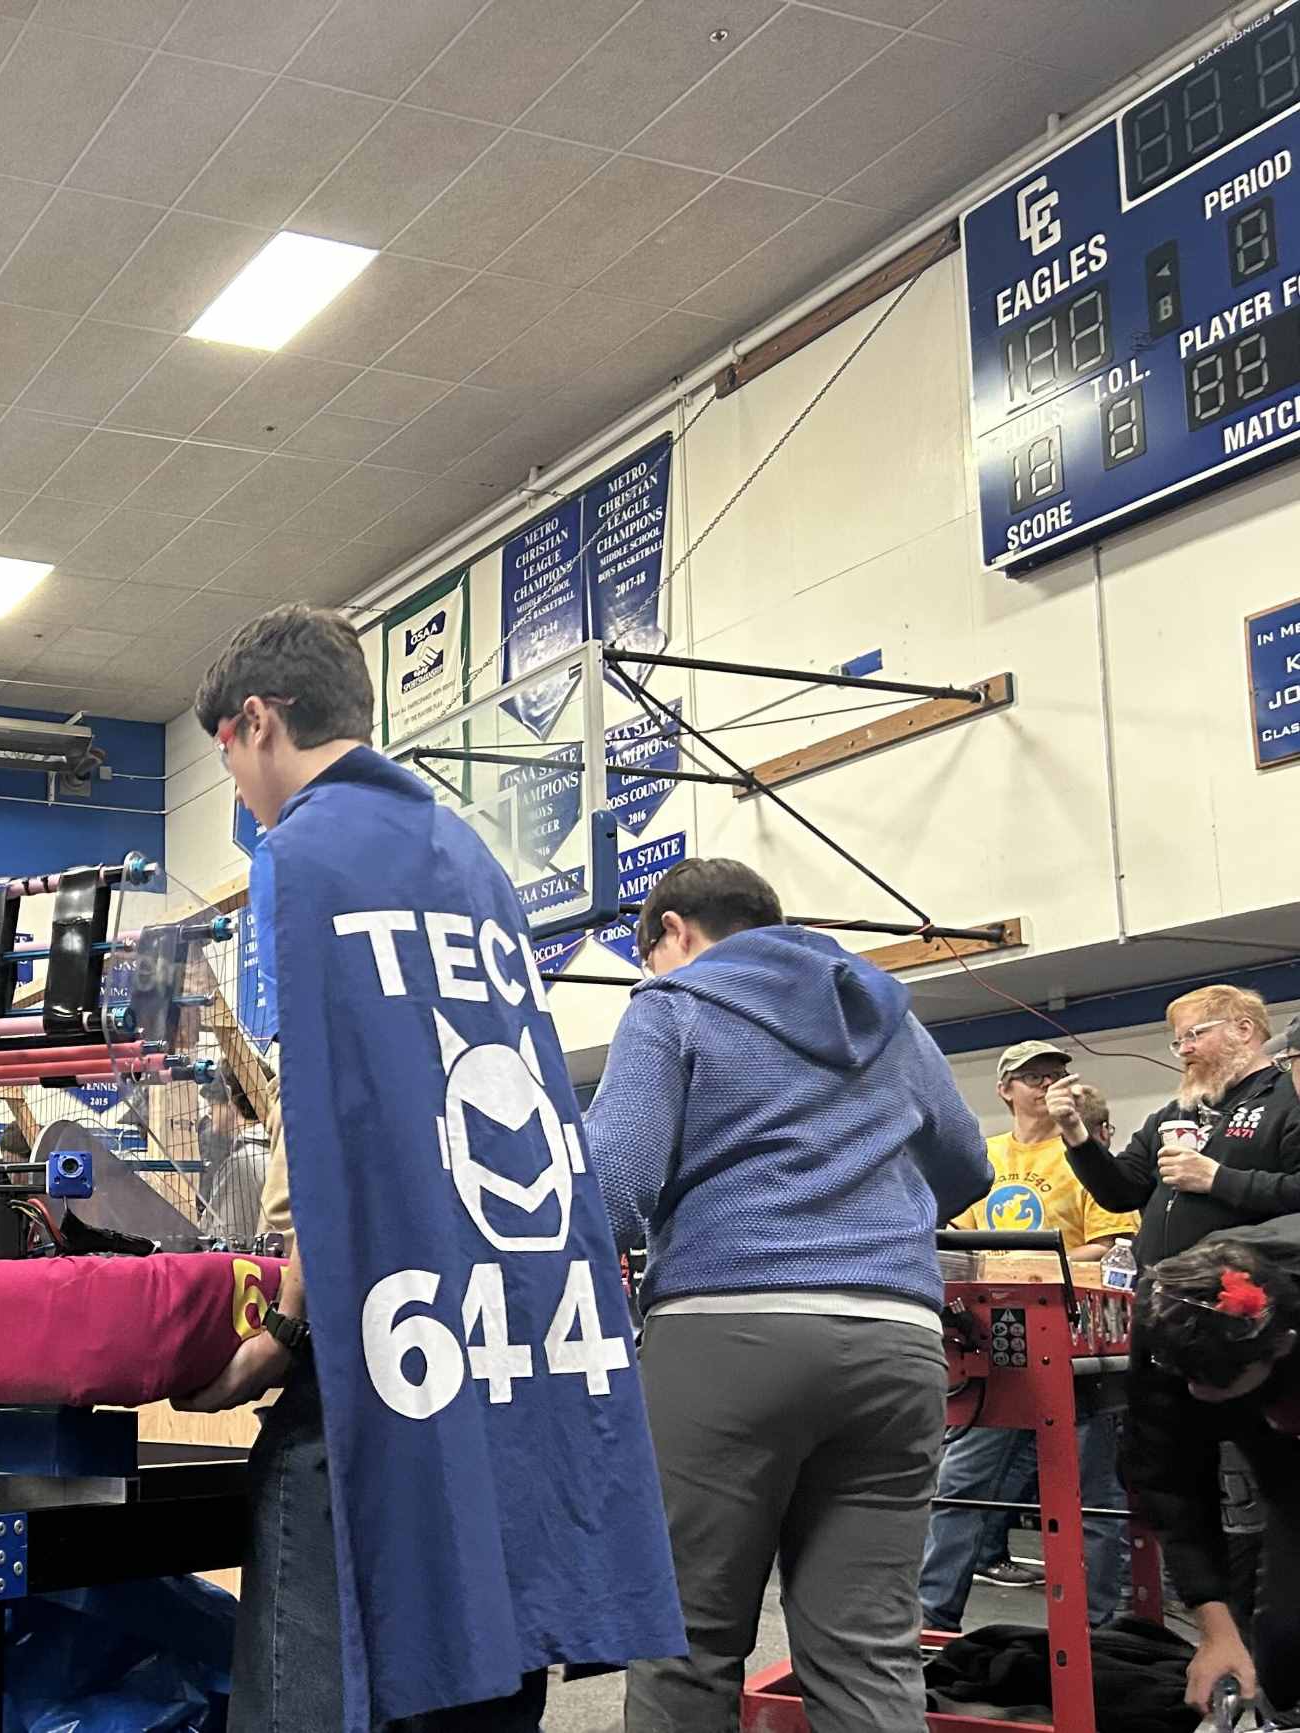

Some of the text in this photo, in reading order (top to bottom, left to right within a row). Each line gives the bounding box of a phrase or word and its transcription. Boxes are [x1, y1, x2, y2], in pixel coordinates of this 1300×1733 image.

[1198, 13, 1271, 65] DAKTRONICS
[1204, 150, 1292, 220] PERIOD
[996, 233, 1109, 326] EAGLES
[1179, 290, 1273, 359] PLAYER
[1089, 357, 1150, 402] T.O.L.
[598, 472, 659, 518] CHRISTIAN
[607, 462, 647, 496] METRO
[596, 506, 663, 554] CHAMPIONS
[606, 495, 651, 531] LEAGUE
[1006, 501, 1073, 550] SCORE
[515, 528, 569, 568] CHRISTIAN
[524, 517, 559, 547] METRO
[600, 527, 661, 567] MIDDLE SCHOOL
[523, 549, 562, 581] LEAGUE
[410, 622, 438, 645] OSAA
[1257, 632, 1274, 646] IN
[605, 793, 629, 811] ROSS
[628, 810, 646, 826] 2016
[636, 838, 680, 867] STATE
[600, 925, 631, 943] CROSS
[533, 943, 564, 962] OCCER
[1225, 1128, 1256, 1139] 2471
[1024, 1171, 1052, 1193] 1540
